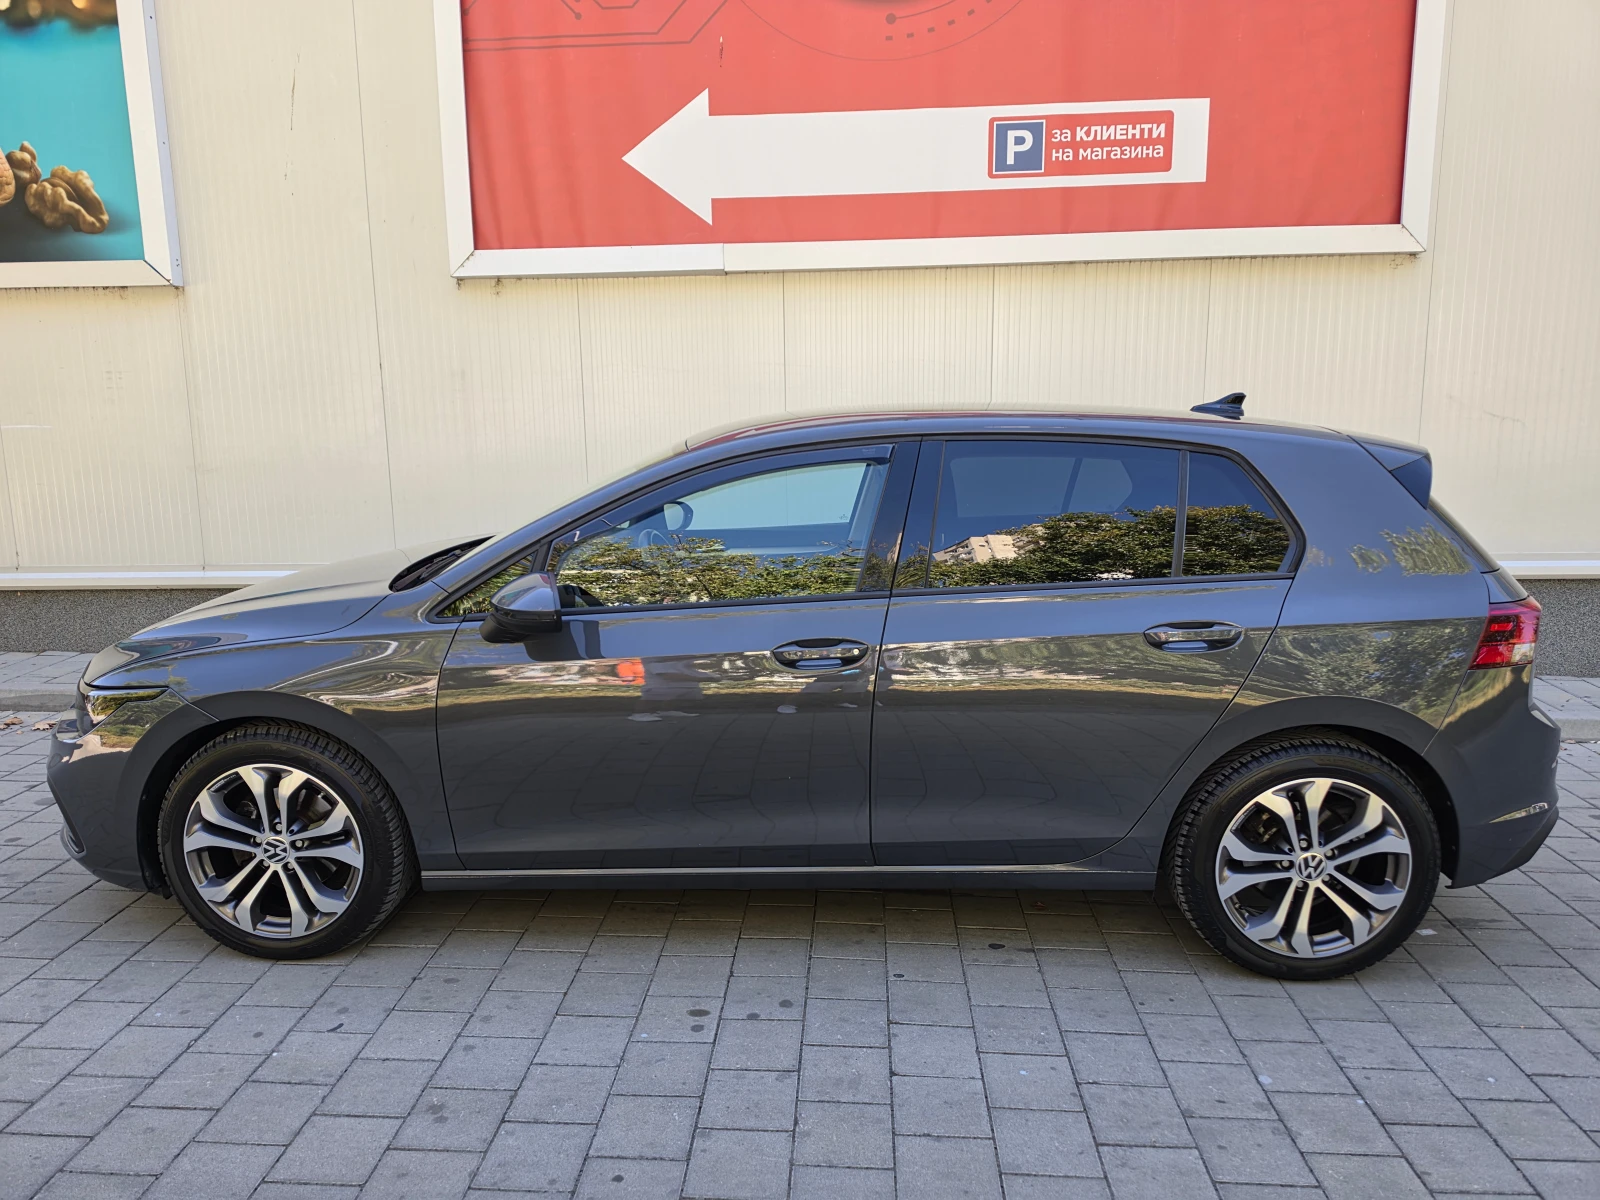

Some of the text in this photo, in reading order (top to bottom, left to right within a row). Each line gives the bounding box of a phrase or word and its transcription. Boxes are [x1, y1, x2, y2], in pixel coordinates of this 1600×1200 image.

[1051, 123, 1166, 142] за КЛИЕНТИ
[1006, 129, 1034, 165] P
[1051, 145, 1164, 161] на магазина
